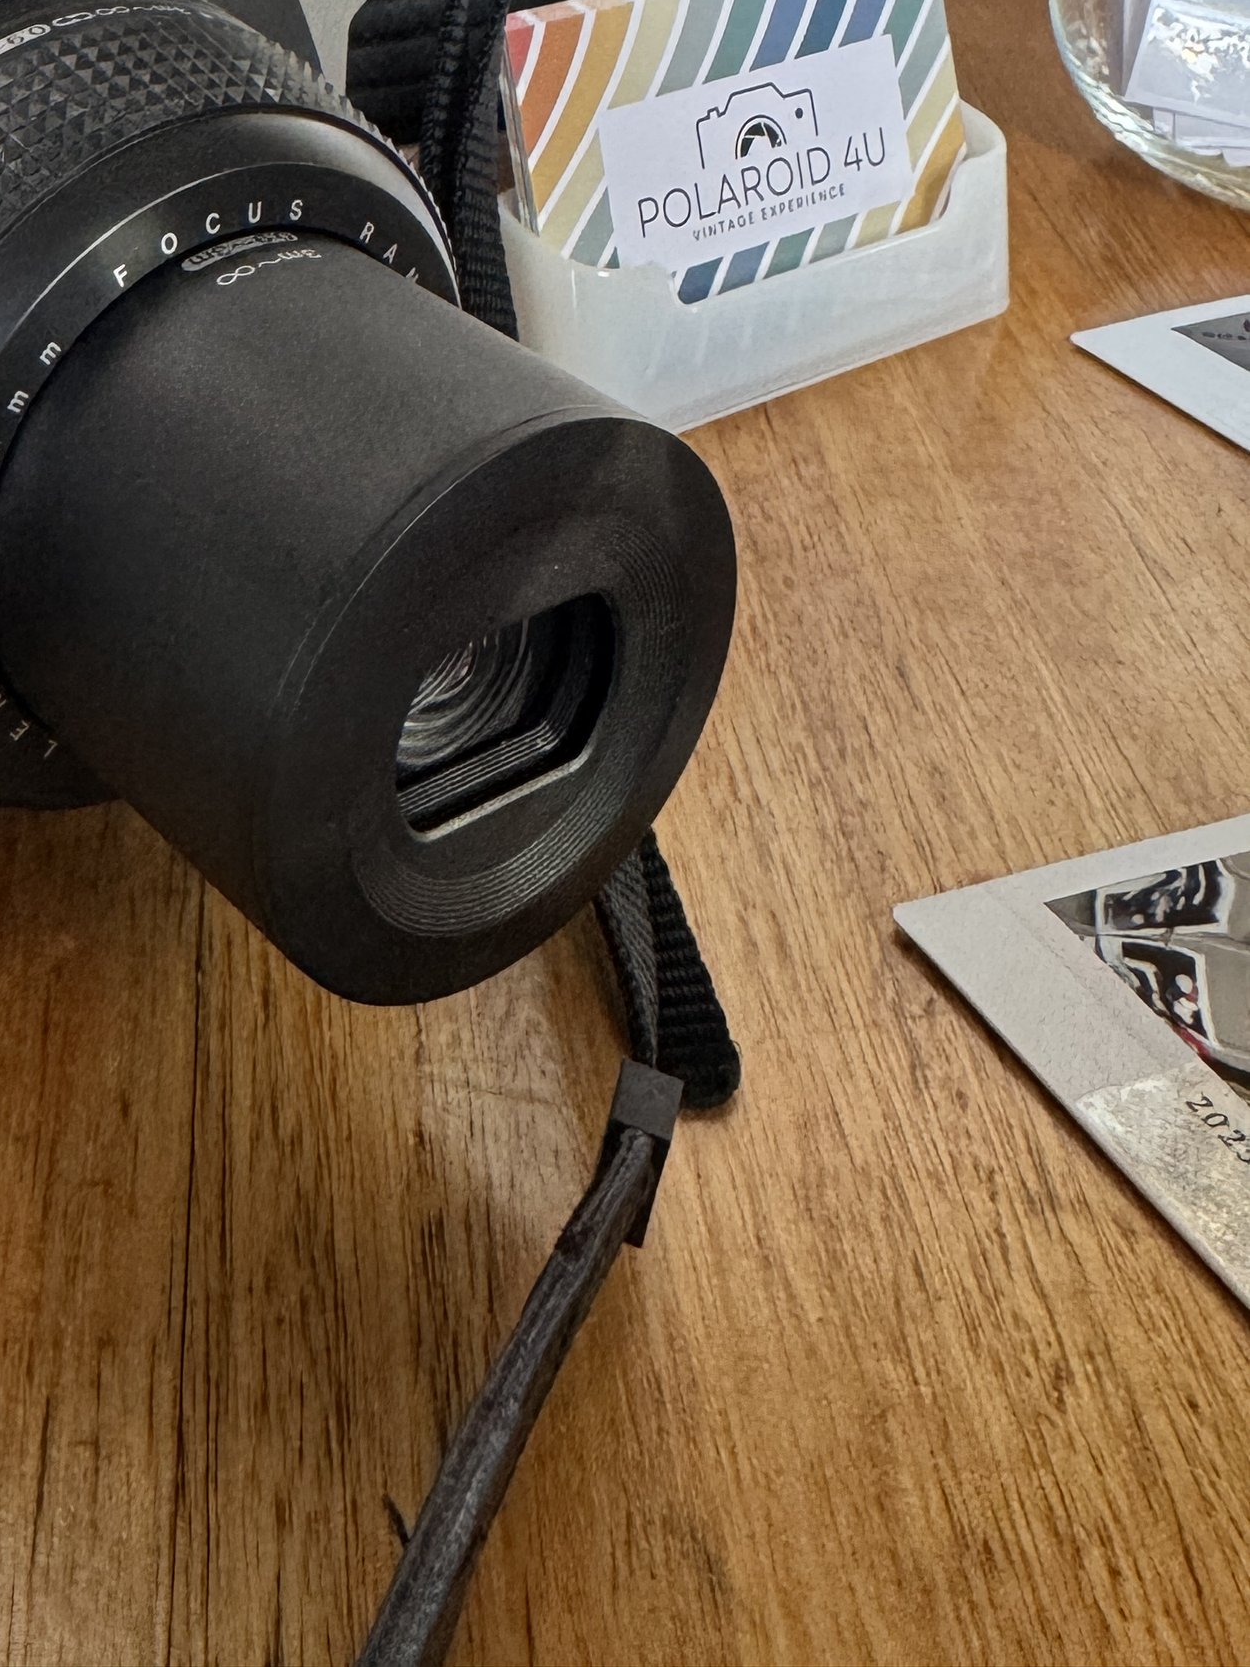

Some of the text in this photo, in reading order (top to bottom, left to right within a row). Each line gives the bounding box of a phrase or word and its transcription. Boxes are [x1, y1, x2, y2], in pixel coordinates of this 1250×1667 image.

[637, 127, 887, 238] POLAROID 4U
[692, 182, 846, 242] VINTAGE EXPERIENCE
[112, 199, 305, 288] FOCUS
